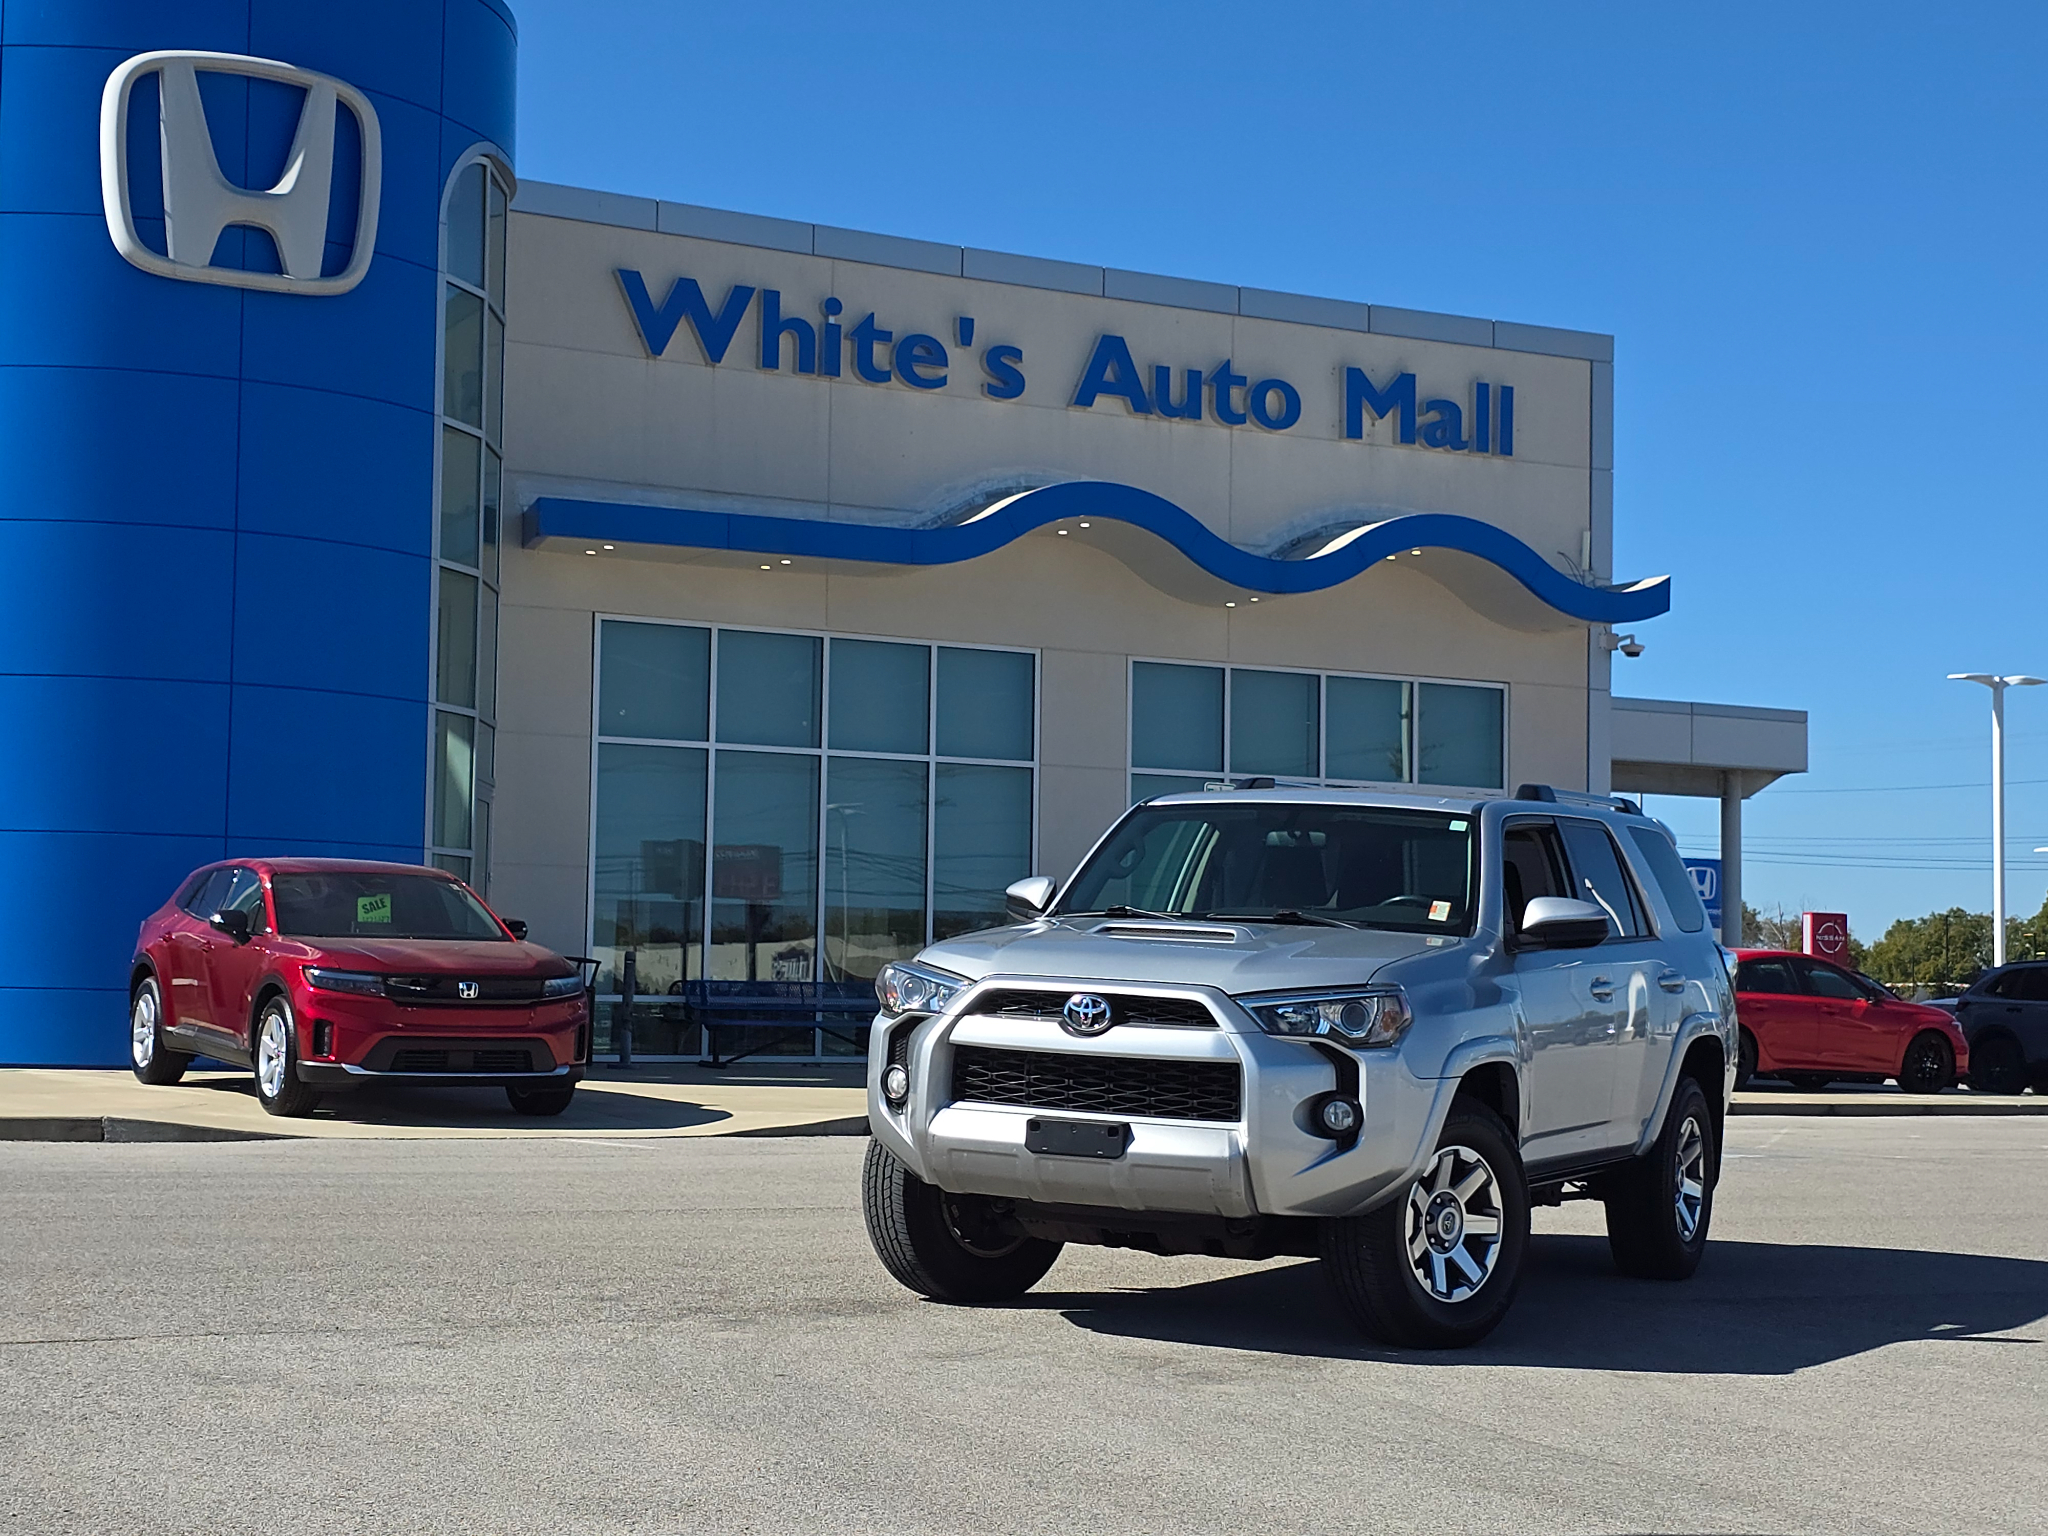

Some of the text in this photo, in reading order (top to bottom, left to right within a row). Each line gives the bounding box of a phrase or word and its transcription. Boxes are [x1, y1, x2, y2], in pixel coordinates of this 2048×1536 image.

[613, 268, 1515, 457] White's Auto Mall
[361, 897, 387, 915] SALE
